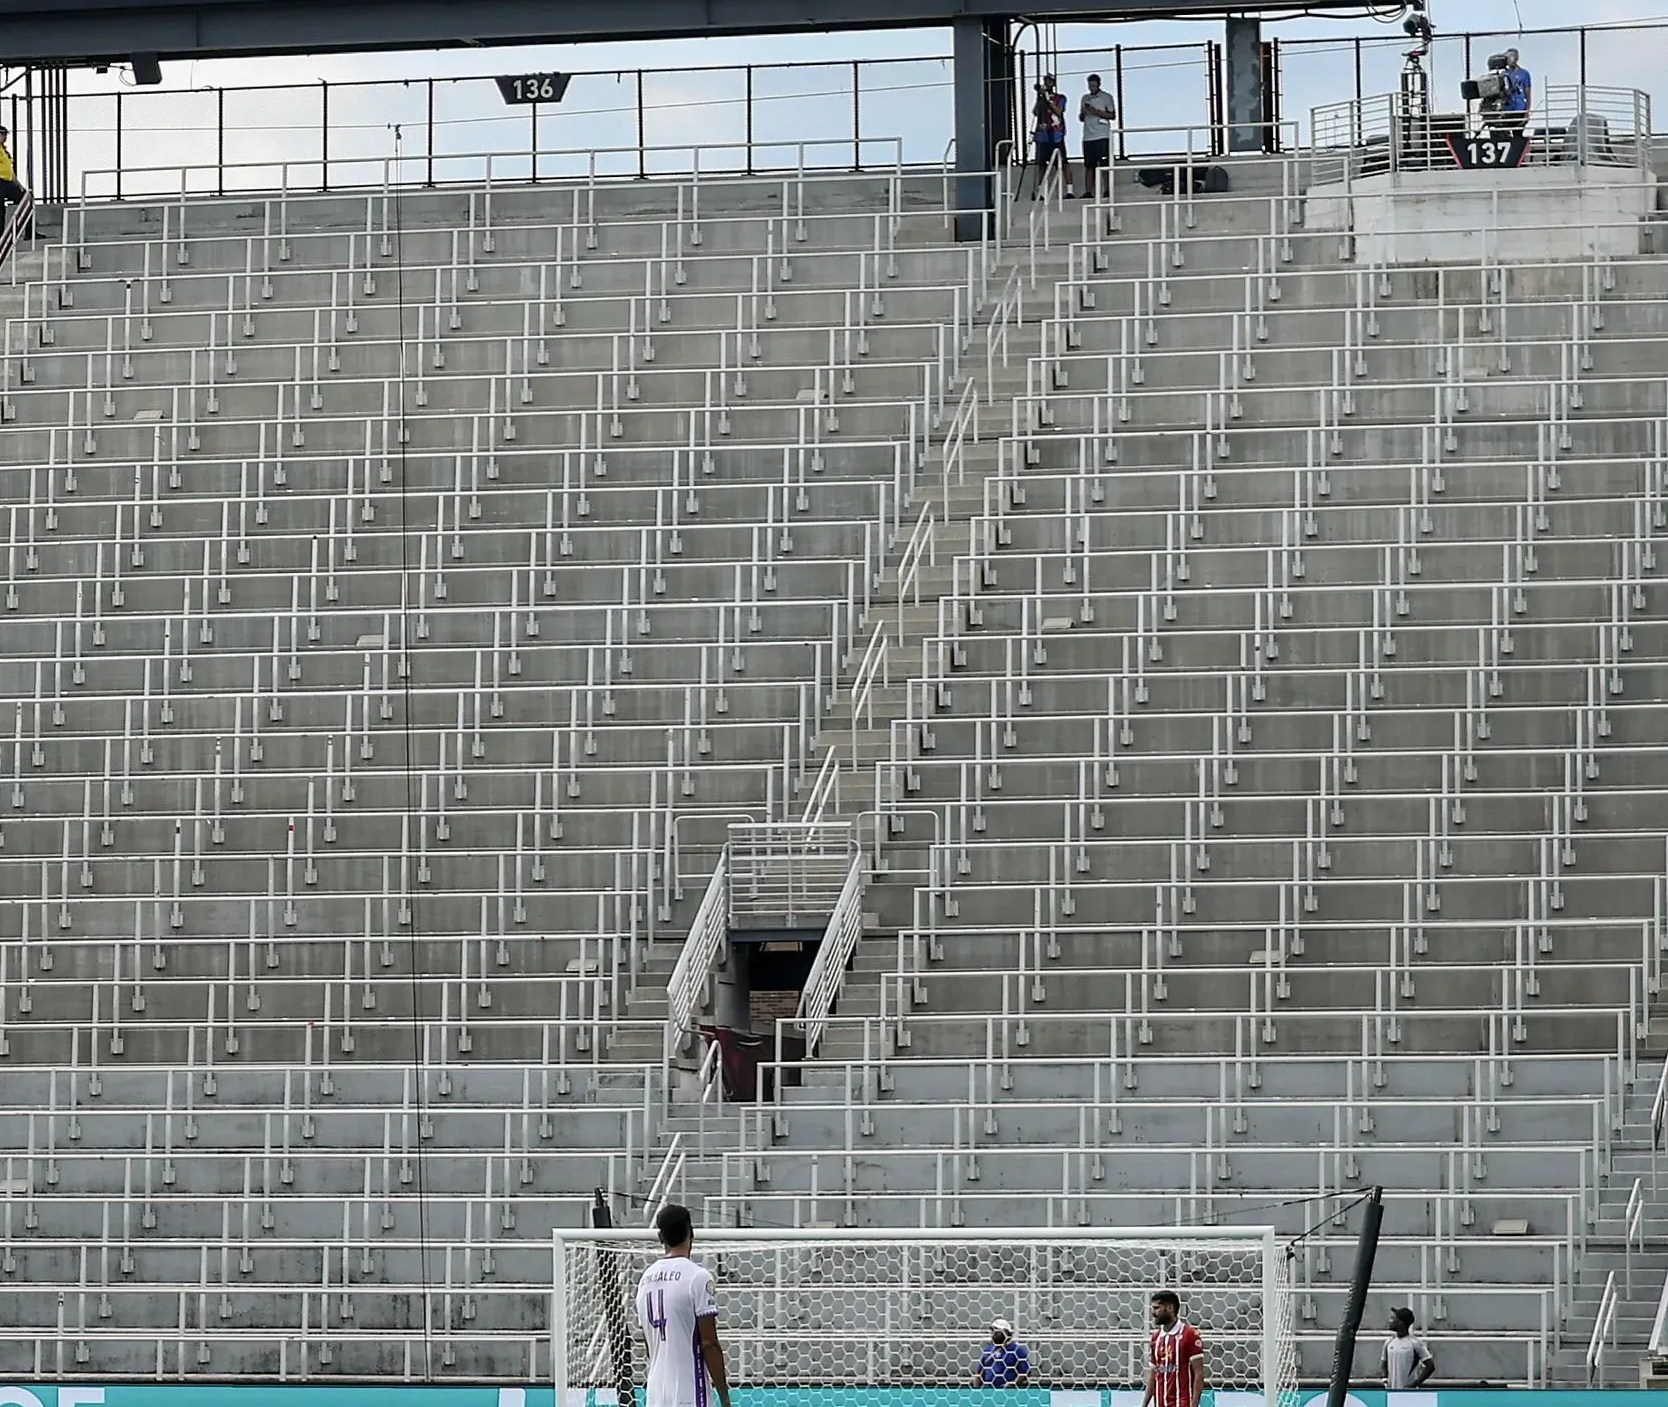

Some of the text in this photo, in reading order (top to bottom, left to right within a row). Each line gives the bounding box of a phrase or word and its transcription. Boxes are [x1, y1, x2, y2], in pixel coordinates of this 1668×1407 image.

[513, 78, 553, 100] 136
[1467, 141, 1513, 164] 137
[646, 1288, 667, 1342] 4
